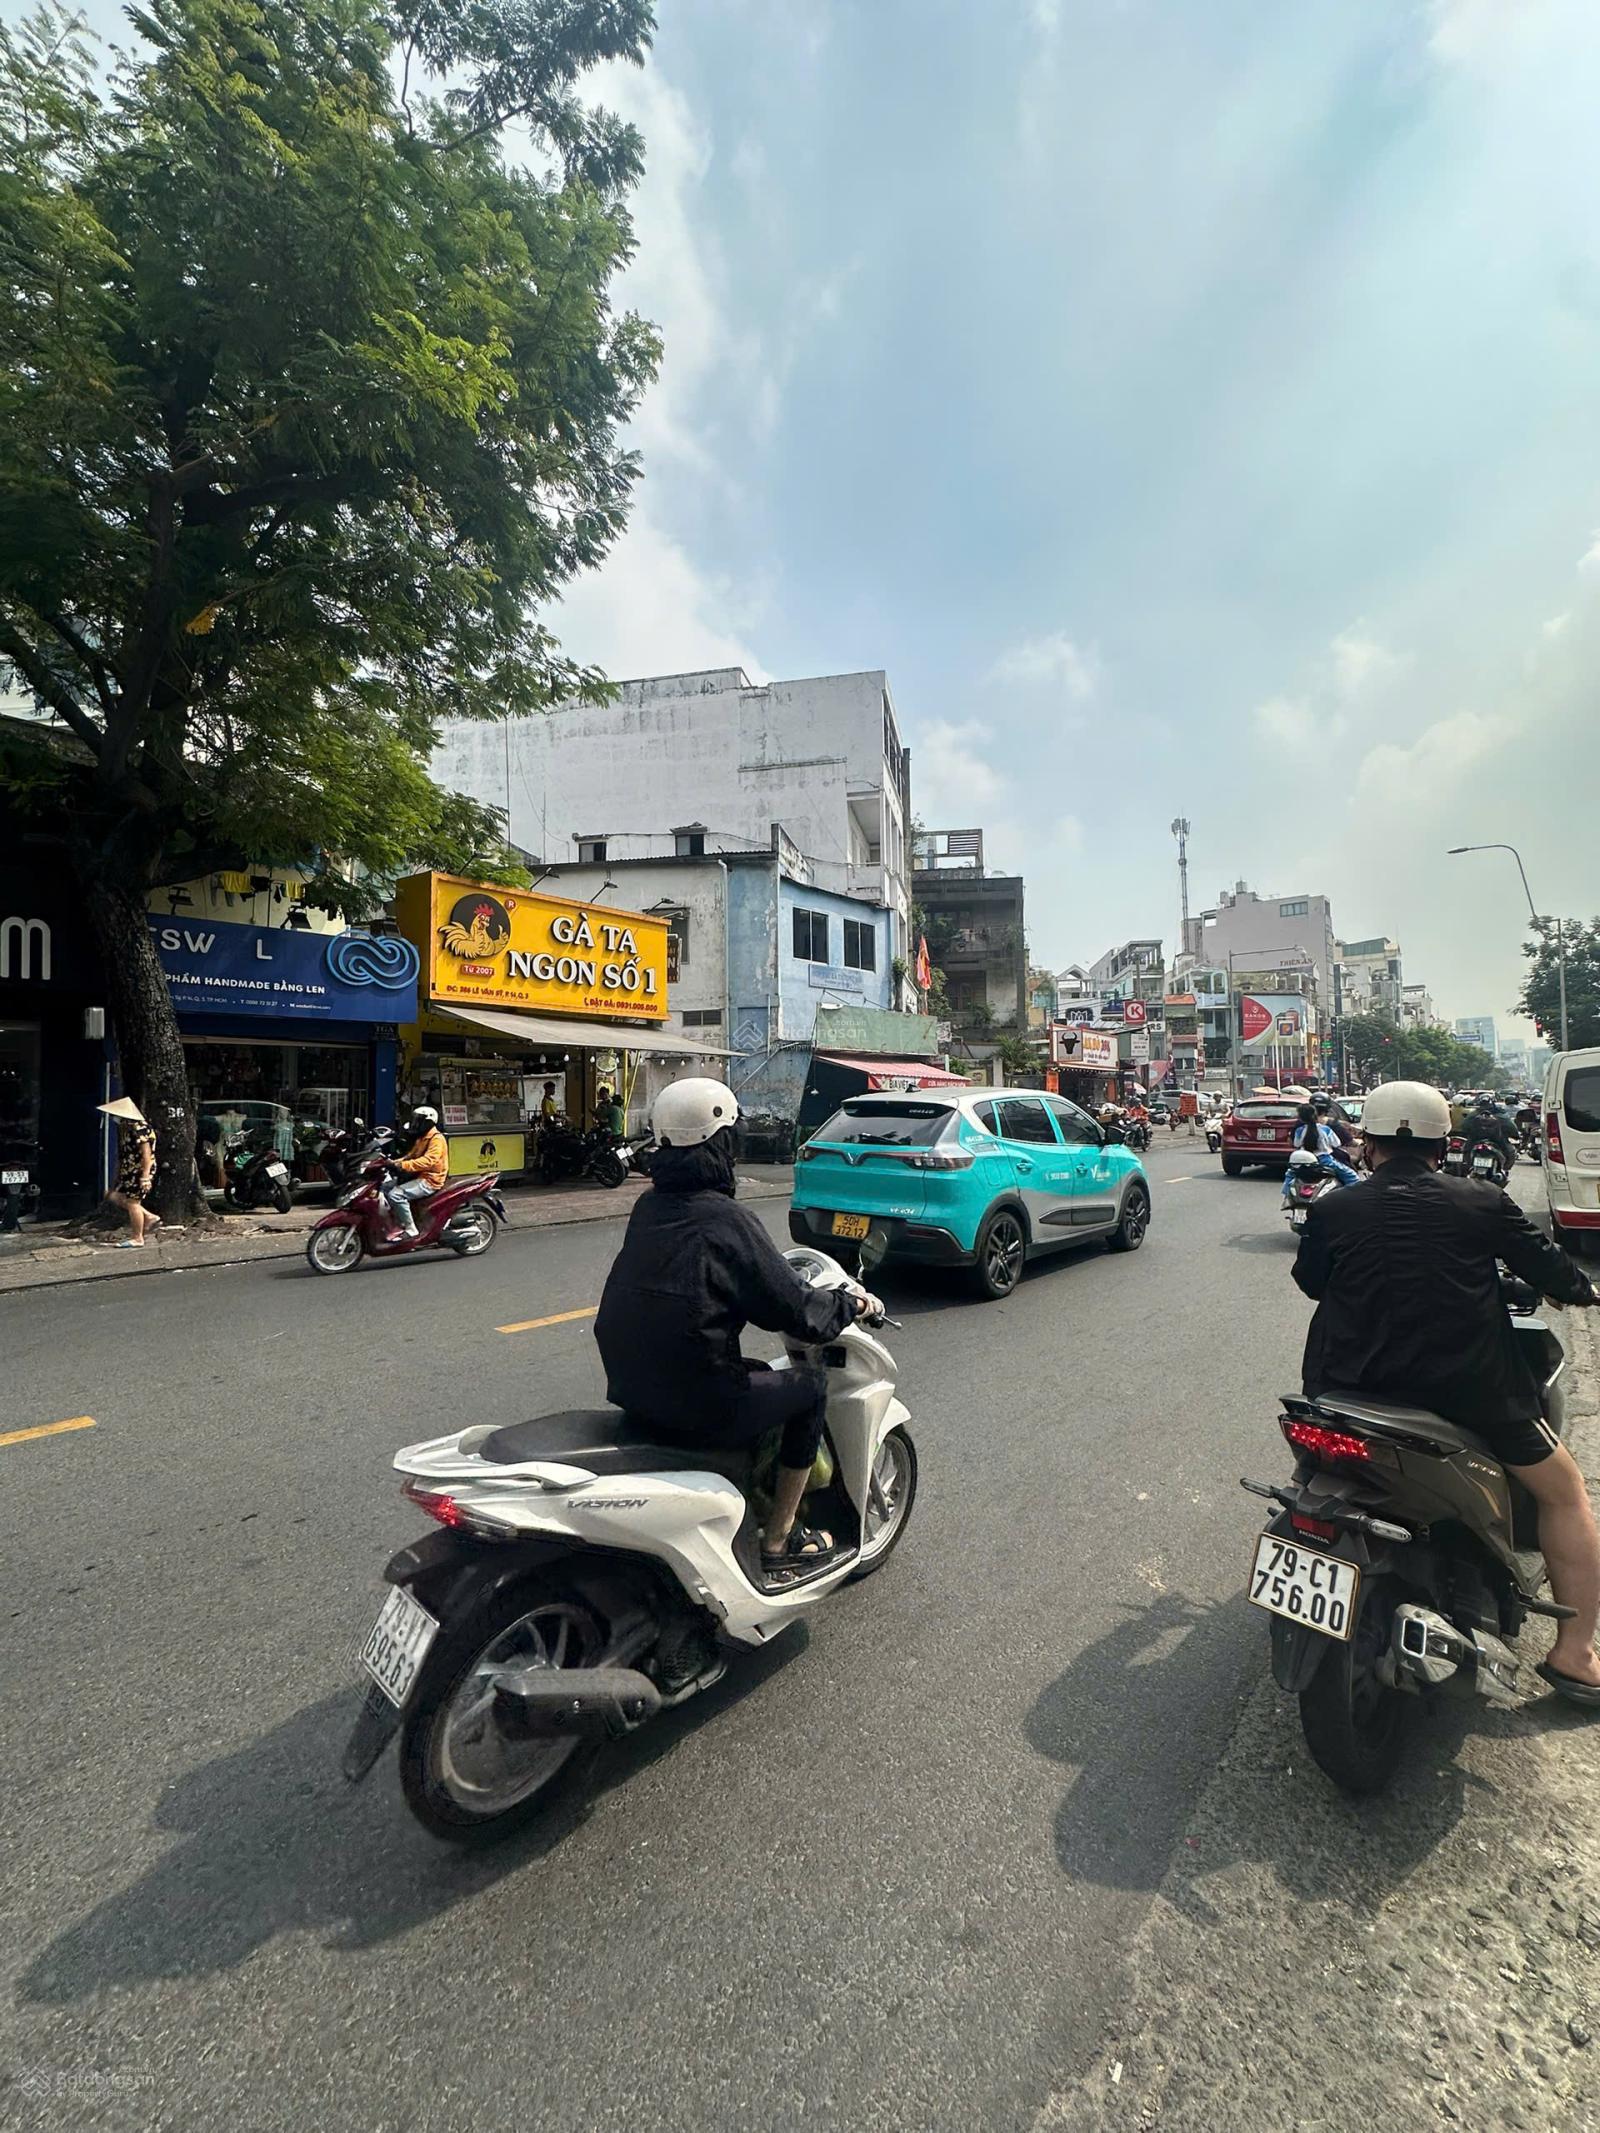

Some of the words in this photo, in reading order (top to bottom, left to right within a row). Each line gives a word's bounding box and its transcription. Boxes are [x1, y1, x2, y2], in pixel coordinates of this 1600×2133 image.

[552, 912, 596, 948] GÀ
[602, 925, 638, 954] TA
[204, 977, 271, 990] HANDMADE
[305, 984, 326, 995] LEN
[475, 966, 494, 976] 2007
[508, 950, 597, 987] NGON
[603, 956, 642, 991] SỐ
[645, 967, 658, 994] 1
[835, 1225, 864, 1239] 372.12
[1298, 1528, 1331, 1545] HONDA
[1268, 1542, 1339, 1594] 79-C1
[1252, 1569, 1345, 1632] 756.00
[363, 1623, 417, 1699] 695.63
